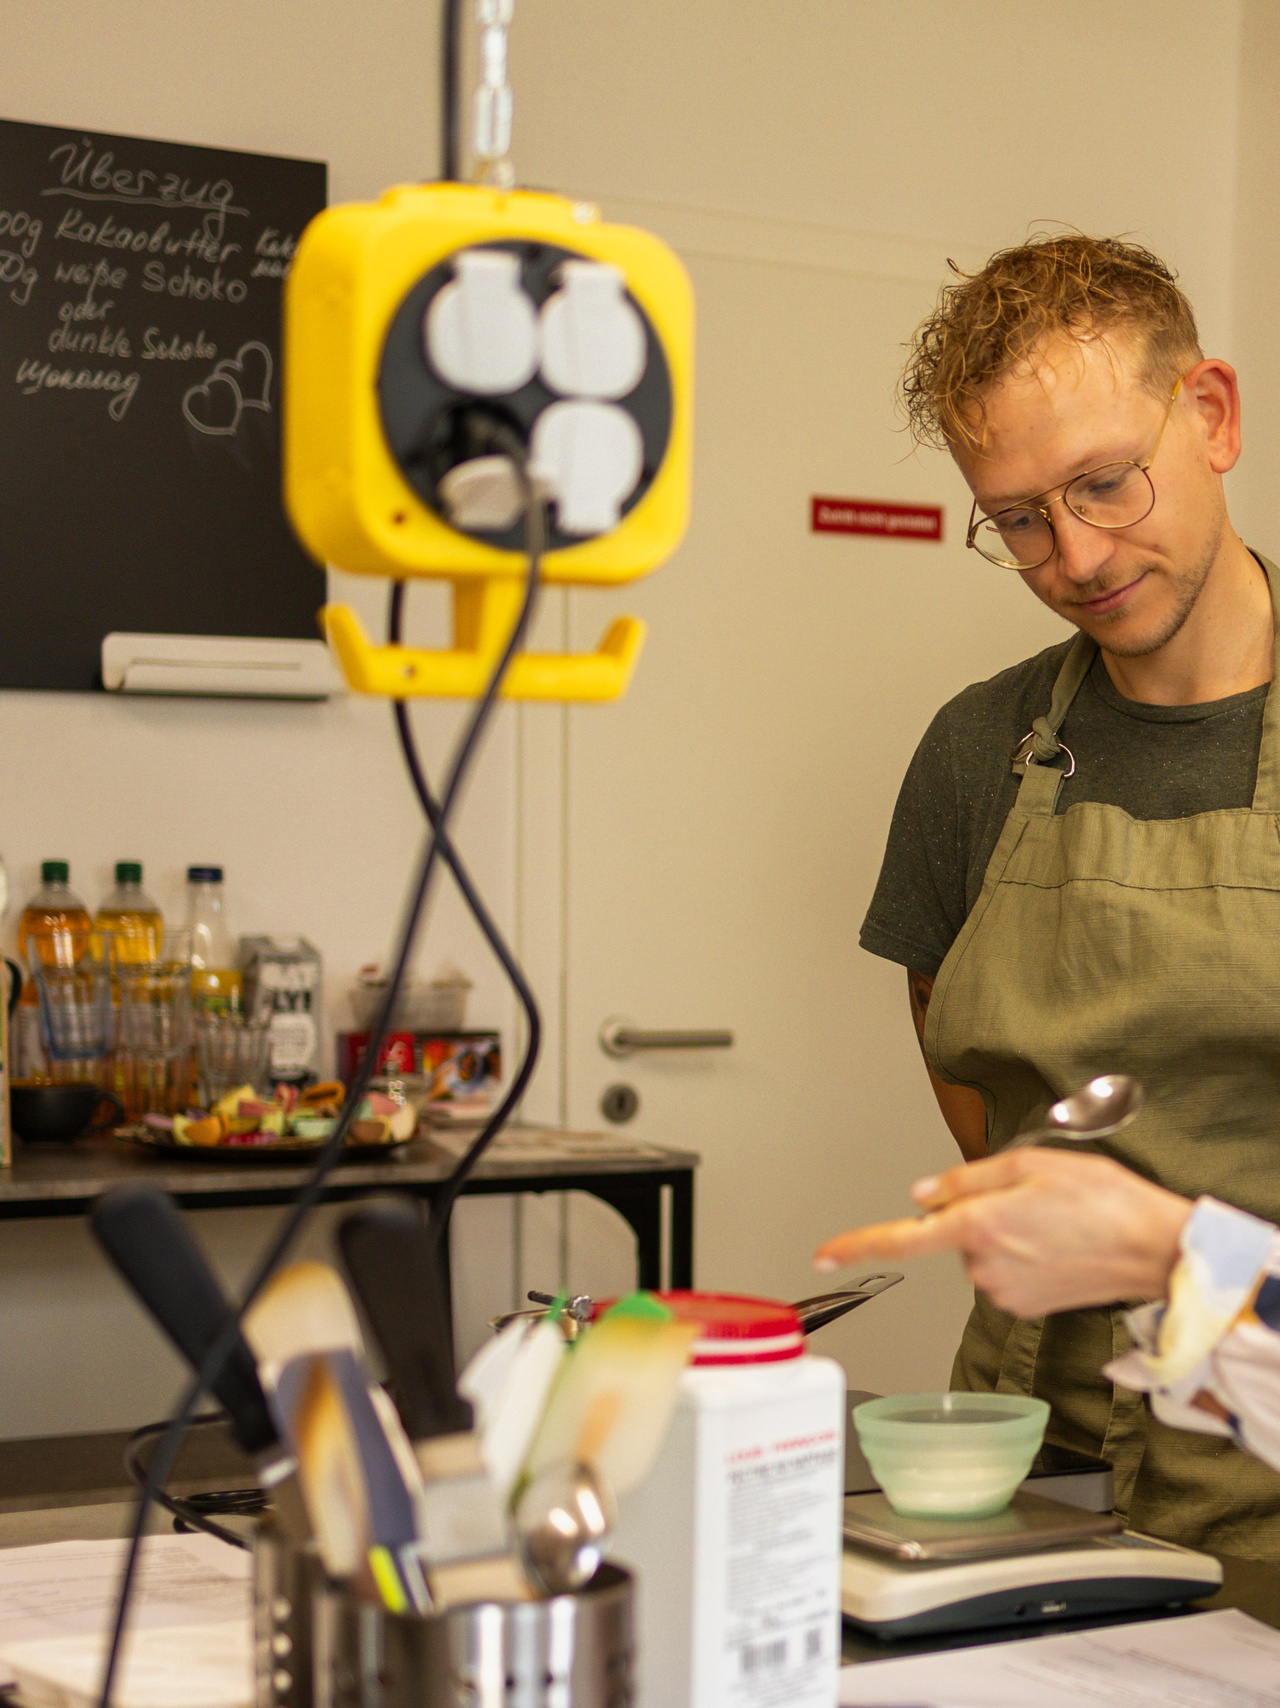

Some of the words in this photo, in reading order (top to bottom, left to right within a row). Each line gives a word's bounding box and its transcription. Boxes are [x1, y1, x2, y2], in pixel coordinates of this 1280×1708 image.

[49, 136, 234, 244] Überzug
[54, 207, 243, 263] Kakaobutter
[141, 260, 248, 304] Schoko
[58, 299, 115, 322] oder
[49, 319, 132, 358] dunkle
[141, 326, 218, 360] Schoko
